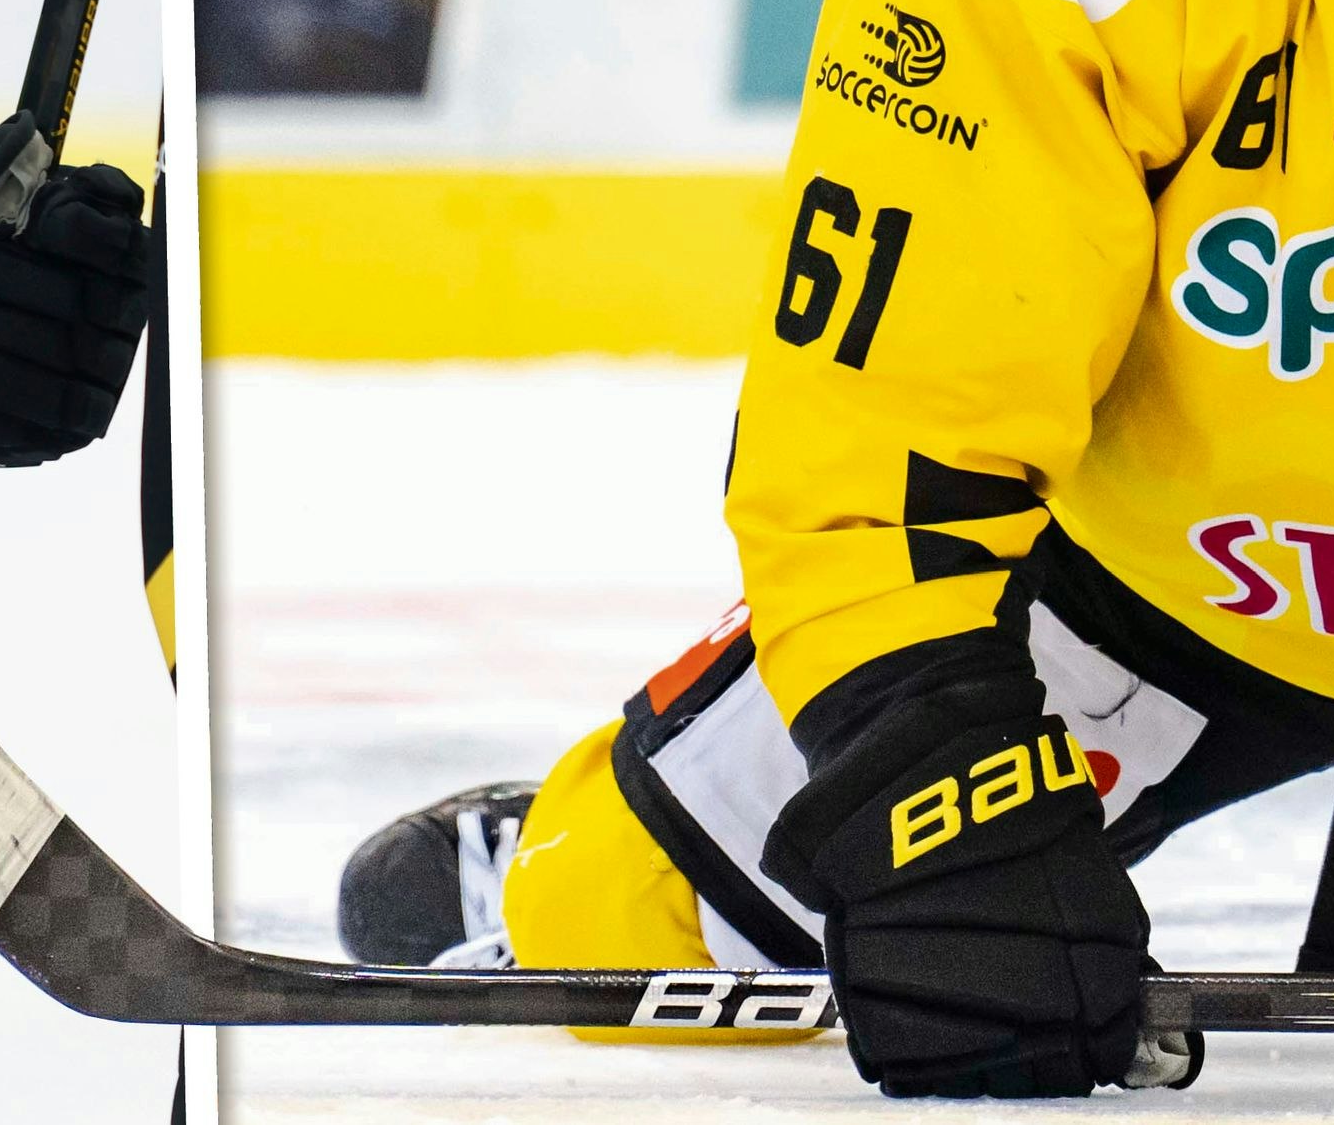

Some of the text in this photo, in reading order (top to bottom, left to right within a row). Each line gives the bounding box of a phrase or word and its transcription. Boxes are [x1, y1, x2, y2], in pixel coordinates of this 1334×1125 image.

[775, 176, 913, 371] 61
[891, 731, 1096, 870] BAU
[628, 972, 845, 1029] BA
